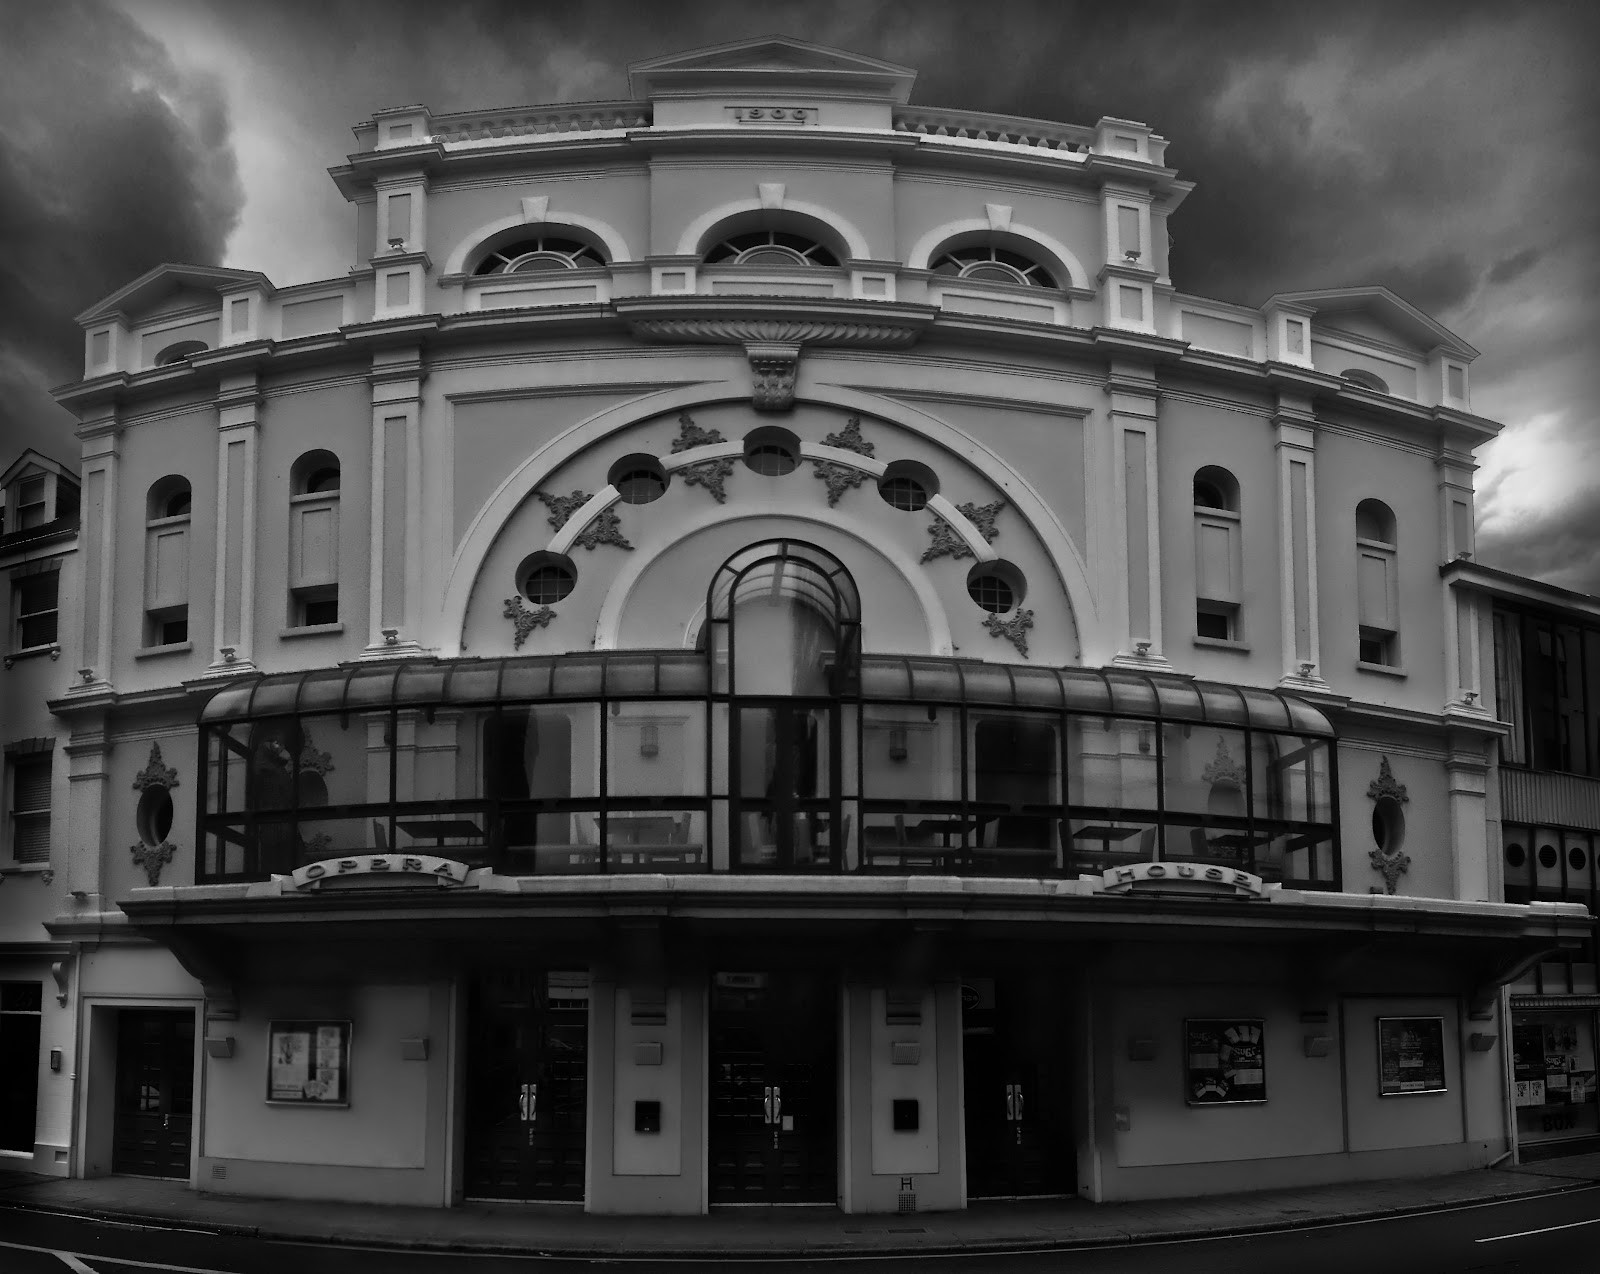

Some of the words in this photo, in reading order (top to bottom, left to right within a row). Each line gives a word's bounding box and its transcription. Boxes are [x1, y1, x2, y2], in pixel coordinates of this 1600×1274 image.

[734, 107, 808, 120] 1900
[305, 857, 453, 879] OPERA
[1115, 865, 1252, 888] HOUSE
[901, 1177, 912, 1190] H
